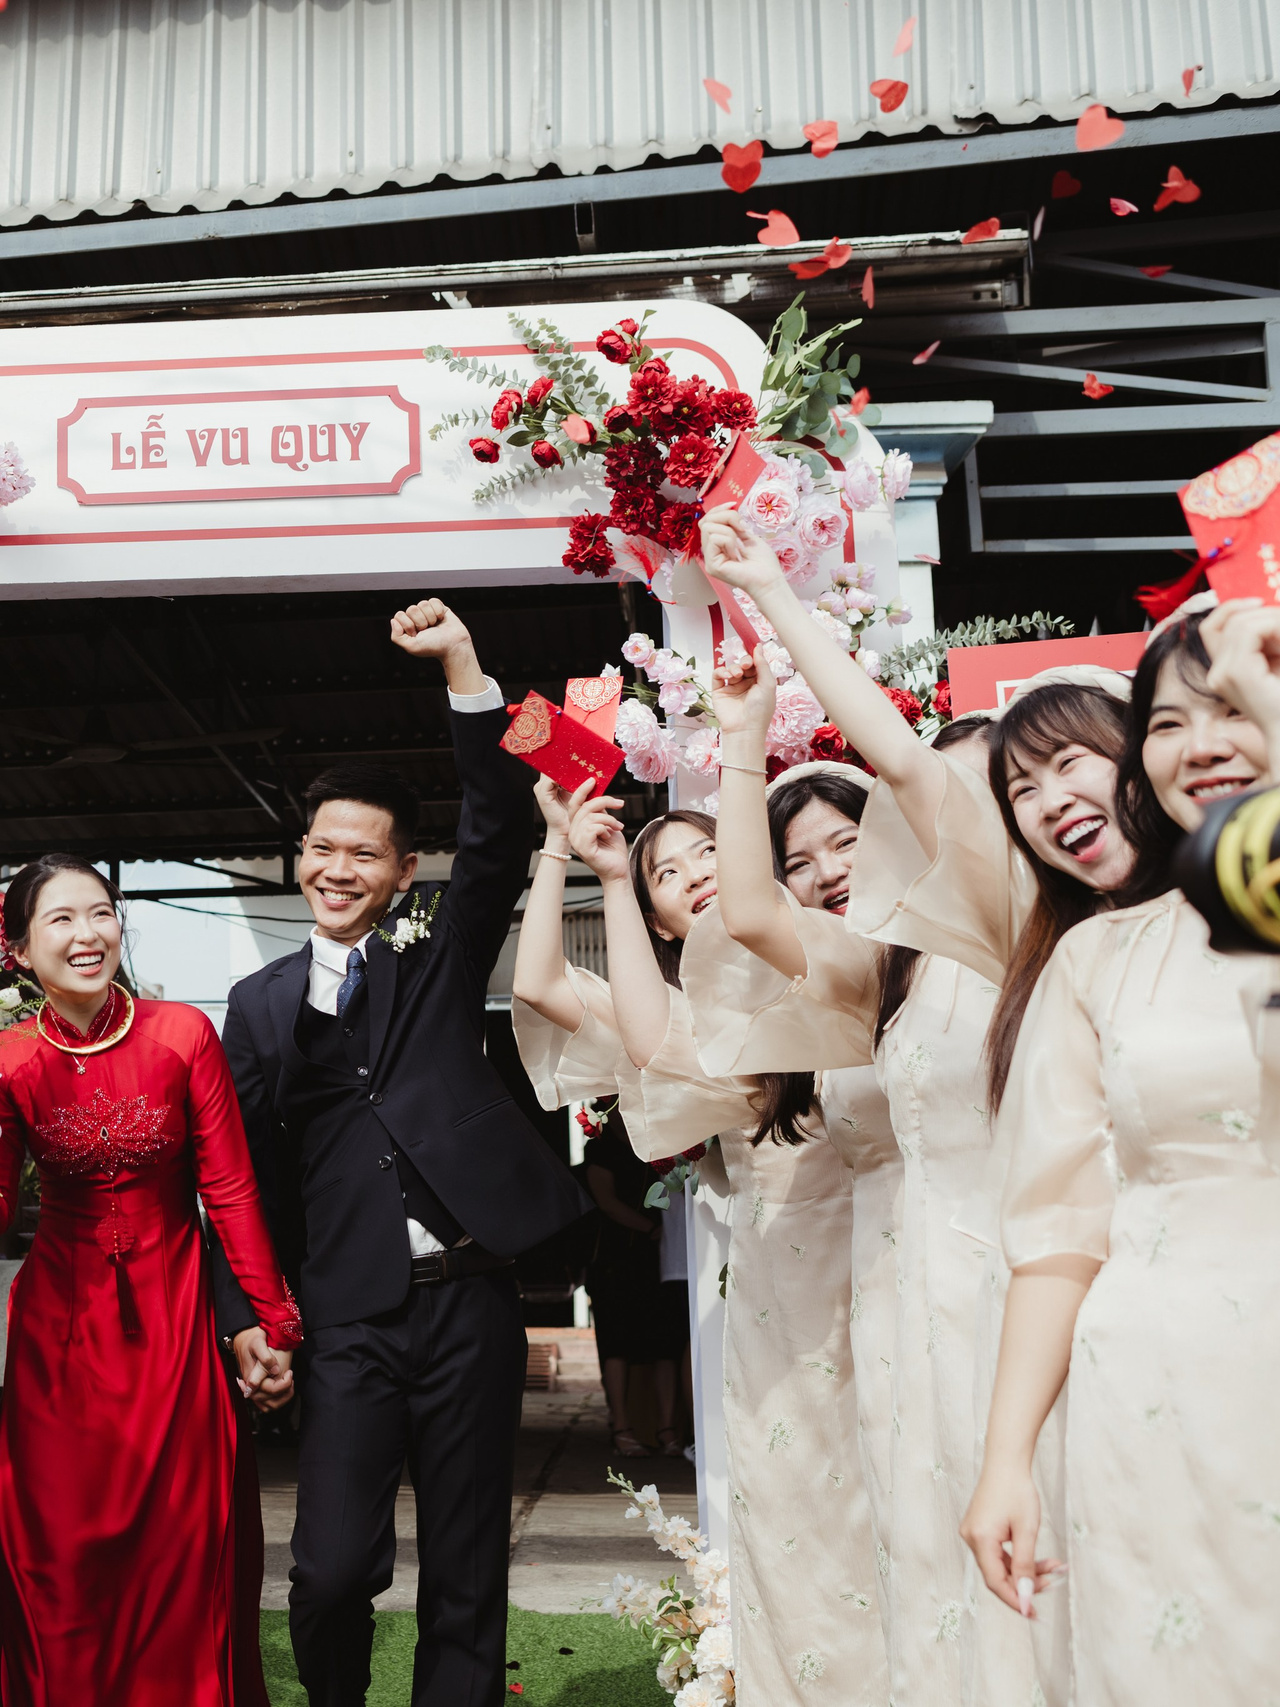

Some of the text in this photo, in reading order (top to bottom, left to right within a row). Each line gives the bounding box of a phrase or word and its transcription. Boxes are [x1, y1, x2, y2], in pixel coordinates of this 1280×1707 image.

[110, 413, 371, 472] LỄ VU QUY
